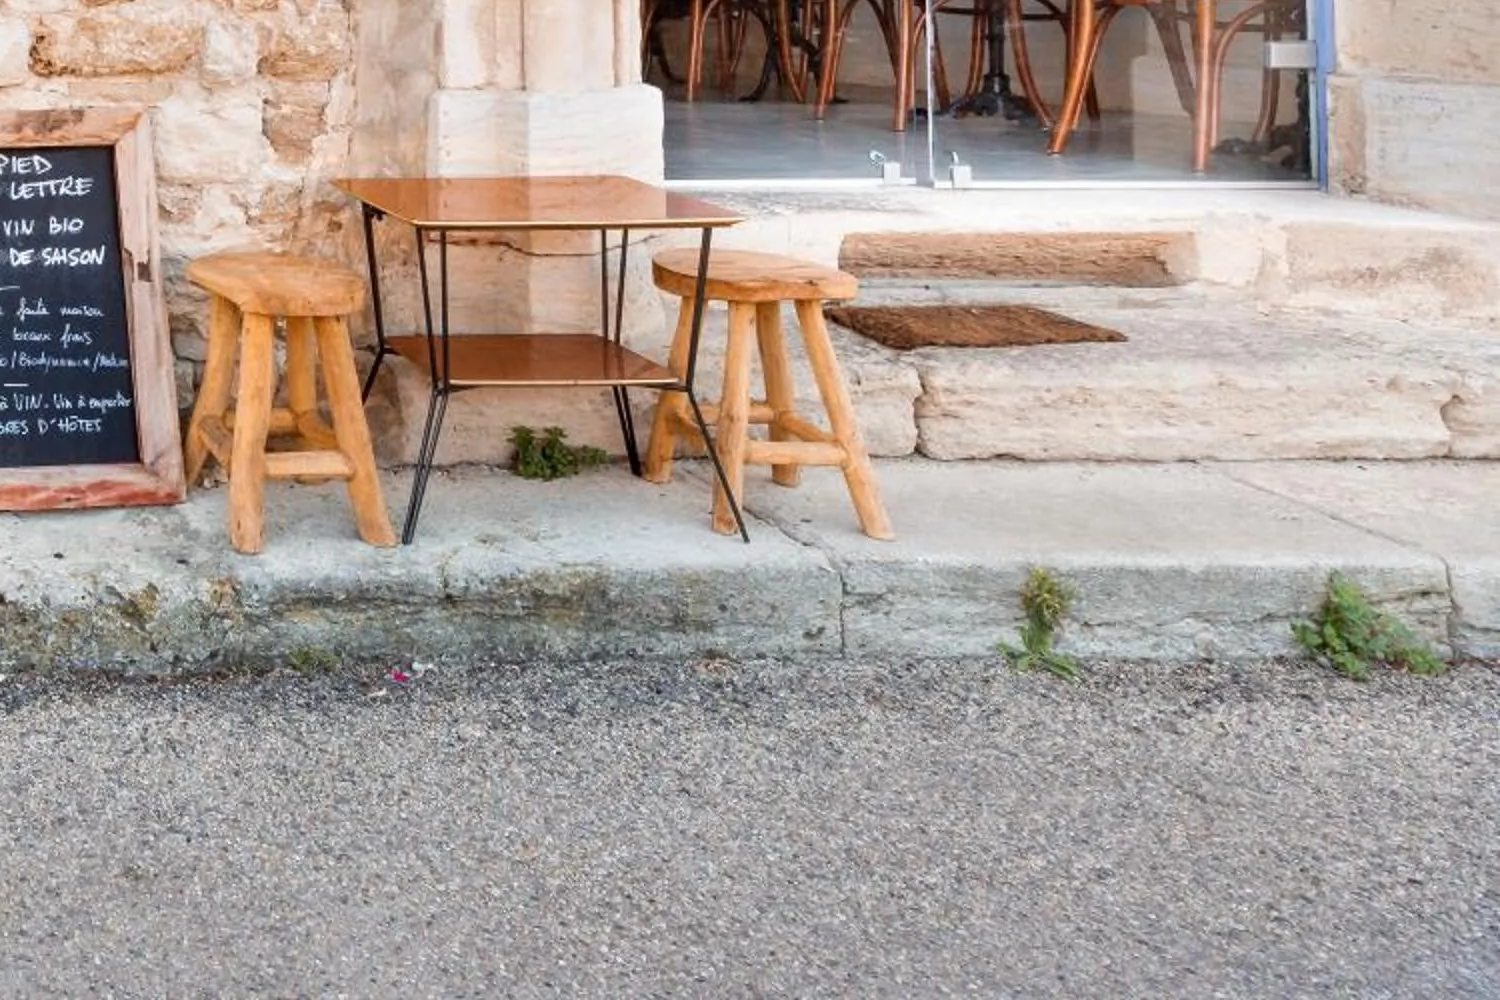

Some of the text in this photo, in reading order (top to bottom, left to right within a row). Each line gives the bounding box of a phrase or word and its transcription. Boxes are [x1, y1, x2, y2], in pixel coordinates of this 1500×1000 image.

[10, 176, 95, 200] LETTRE
[2, 218, 36, 237] VIN
[49, 216, 85, 236] BIO
[9, 248, 36, 268] DE
[41, 244, 106, 268] SAISON
